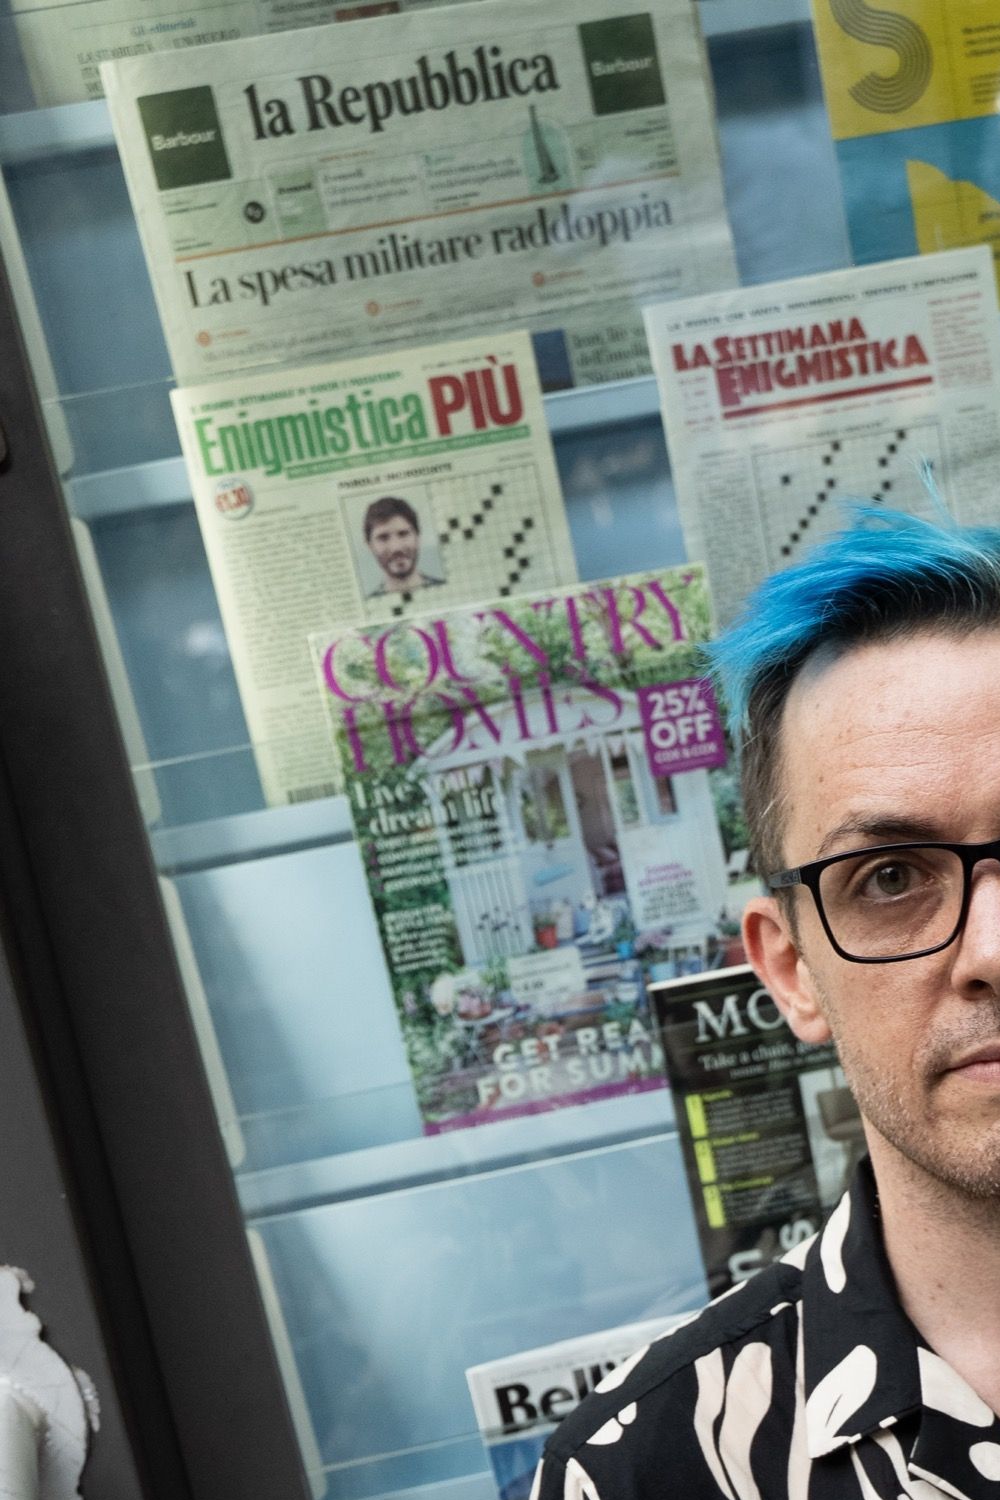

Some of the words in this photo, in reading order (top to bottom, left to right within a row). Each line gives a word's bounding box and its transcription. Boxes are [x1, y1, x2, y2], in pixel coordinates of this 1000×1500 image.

[243, 83, 295, 141] la
[297, 45, 562, 135] Repubblica
[590, 53, 654, 78] Barbour
[152, 127, 217, 153] Barbour
[183, 269, 233, 308] La
[237, 259, 337, 307] spesa
[342, 231, 483, 281] militare
[491, 192, 674, 255] raddoppia
[672, 343, 712, 371] LA
[712, 316, 867, 364] SETTIMANA
[716, 334, 930, 407] ENIGMISTICA
[195, 390, 430, 477] Enigmistica
[428, 354, 525, 437] PIÙ
[322, 574, 696, 704] COUNTRY
[647, 684, 707, 721] 25%
[650, 712, 713, 749] OFF
[693, 988, 787, 1043] MO
[493, 1033, 562, 1072] GET
[575, 1018, 660, 1057] REA
[476, 1066, 552, 1108] FOR
